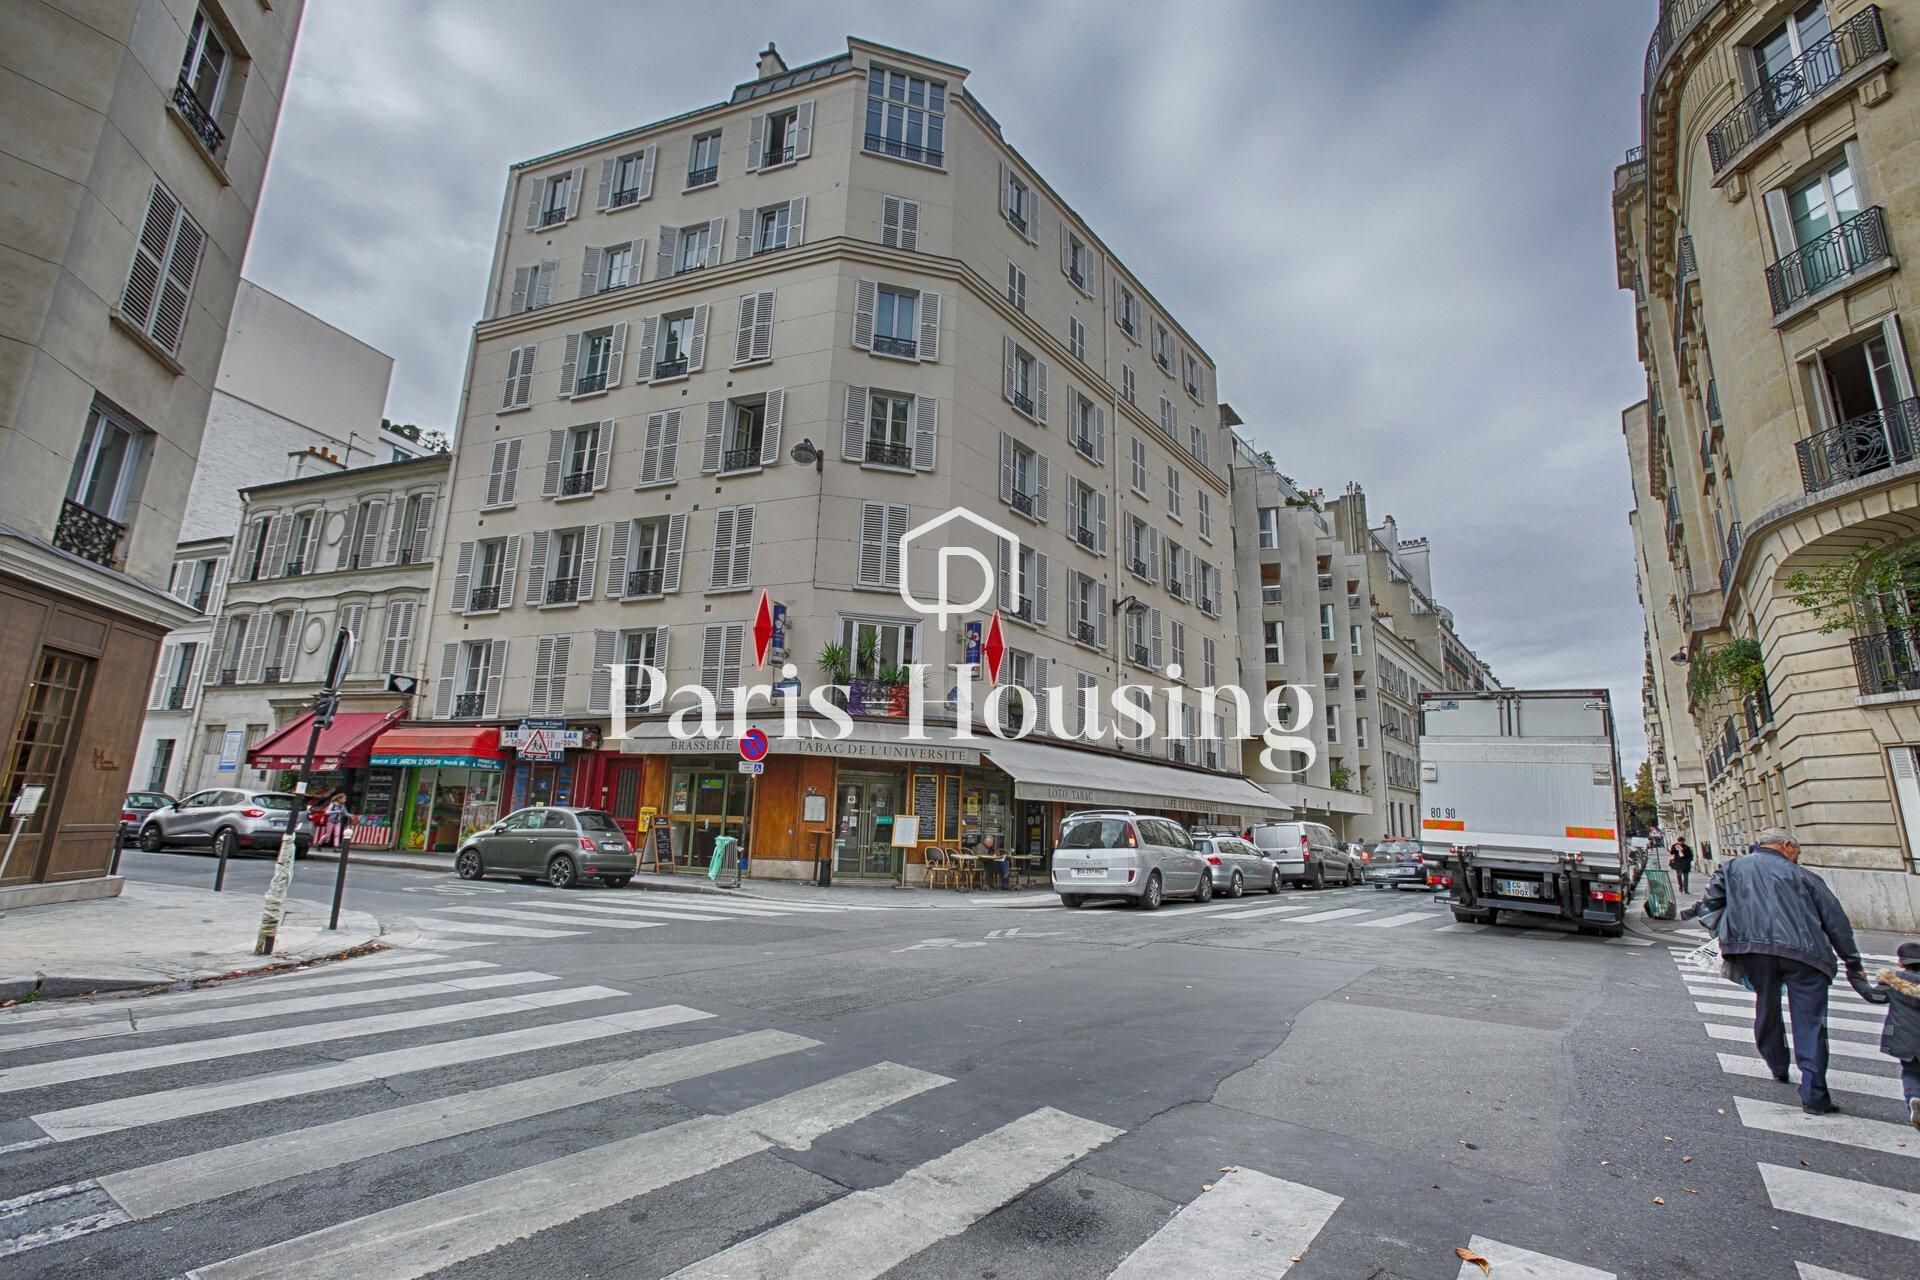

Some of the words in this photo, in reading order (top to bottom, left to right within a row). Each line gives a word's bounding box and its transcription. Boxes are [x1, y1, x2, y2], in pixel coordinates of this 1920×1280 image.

[671, 740, 733, 751] BRASSERIE
[796, 741, 843, 753] TABAC
[847, 744, 867, 756] DE
[870, 746, 966, 761] L'UNIVERSITE
[1047, 788, 1068, 798] LOTO
[1071, 790, 1094, 800] TABAC
[1430, 807, 1441, 818] 80
[1445, 808, 1456, 819] 90
